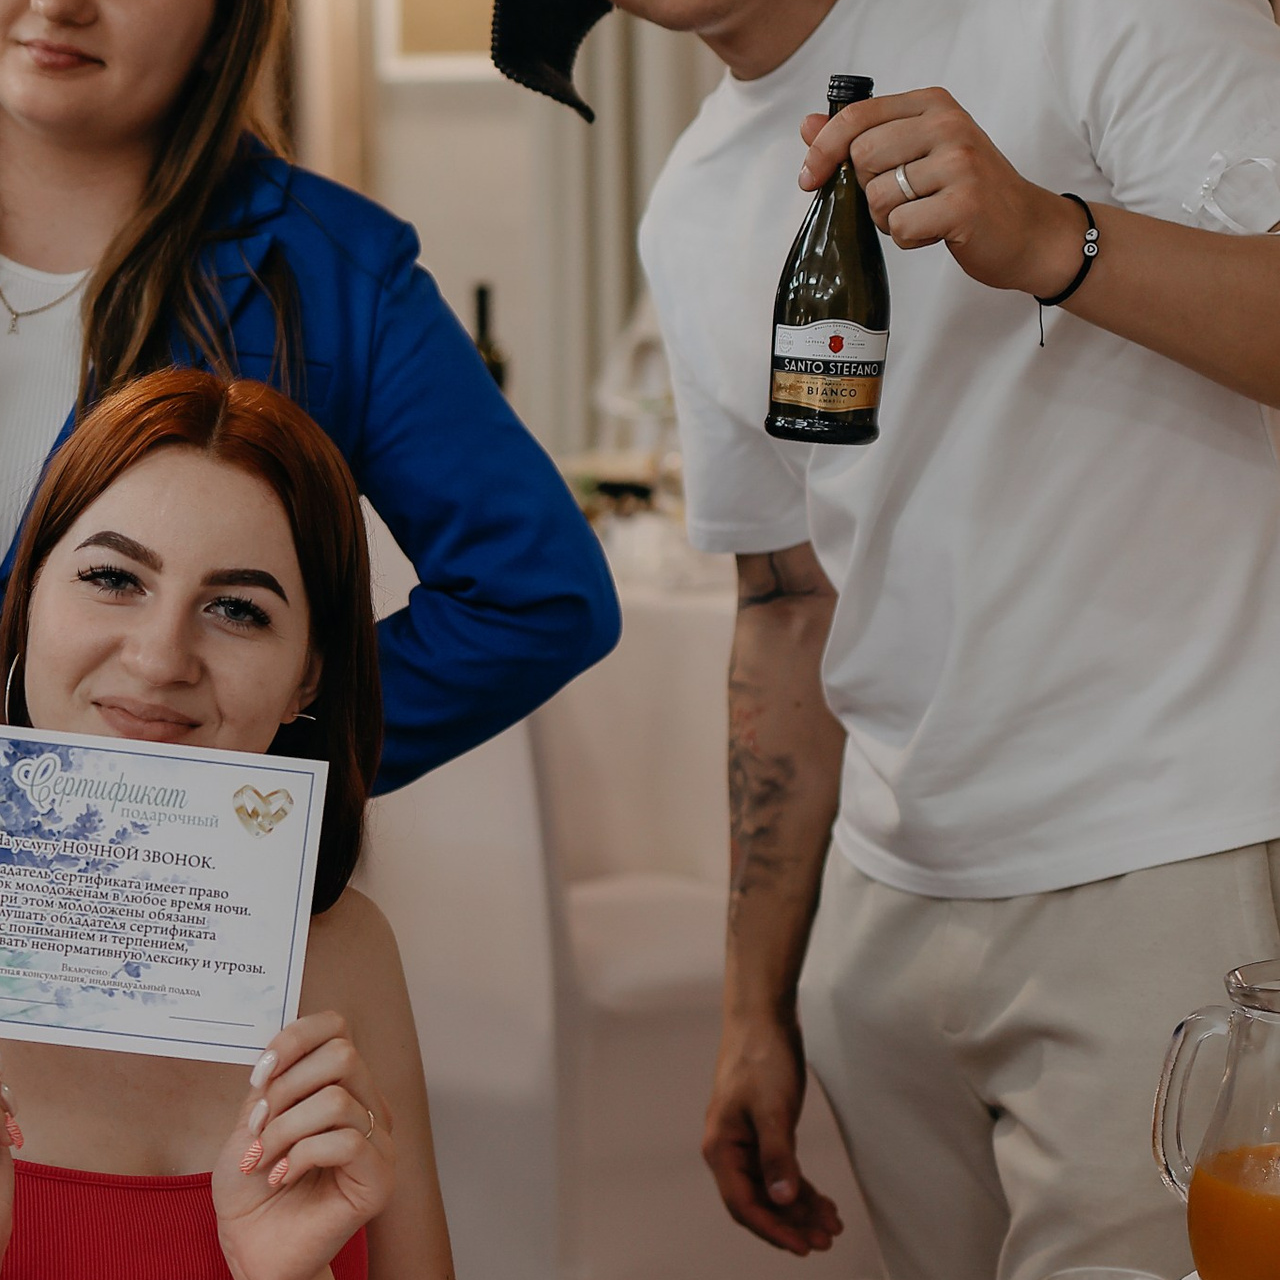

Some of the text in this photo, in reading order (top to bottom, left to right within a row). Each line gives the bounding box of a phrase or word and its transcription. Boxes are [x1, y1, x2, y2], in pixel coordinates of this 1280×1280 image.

[784, 358, 878, 375] SANTO STEFANO
[807, 387, 858, 397] BIANCO
[17, 756, 189, 810] Сертификат
[120, 807, 219, 829] подарочный
[14, 838, 60, 855] услугу
[62, 840, 139, 861] НОЧНОЙ
[141, 849, 216, 870] ЗВОНОК.
[54, 871, 141, 890] сертификата
[144, 881, 186, 895] имеет
[188, 886, 229, 901] право
[20, 896, 55, 909] этом
[147, 907, 206, 926] обязаны
[112, 892, 120, 901] в
[122, 890, 167, 907] любое
[169, 898, 212, 913] время
[214, 903, 251, 916] ночи.
[9, 923, 96, 942] пониманием
[98, 933, 108, 943] и
[110, 934, 189, 954] терпением,
[50, 911, 127, 929] обладателя
[129, 921, 216, 941] сертификата
[31, 940, 143, 962] ненормативную
[144, 953, 200, 971] лексику
[201, 959, 211, 969] и
[213, 960, 266, 976] угрозы.
[61, 963, 110, 976] Включено:
[22, 970, 87, 985] консультация,
[89, 978, 167, 993] индивидуальный
[167, 986, 201, 997] подход
